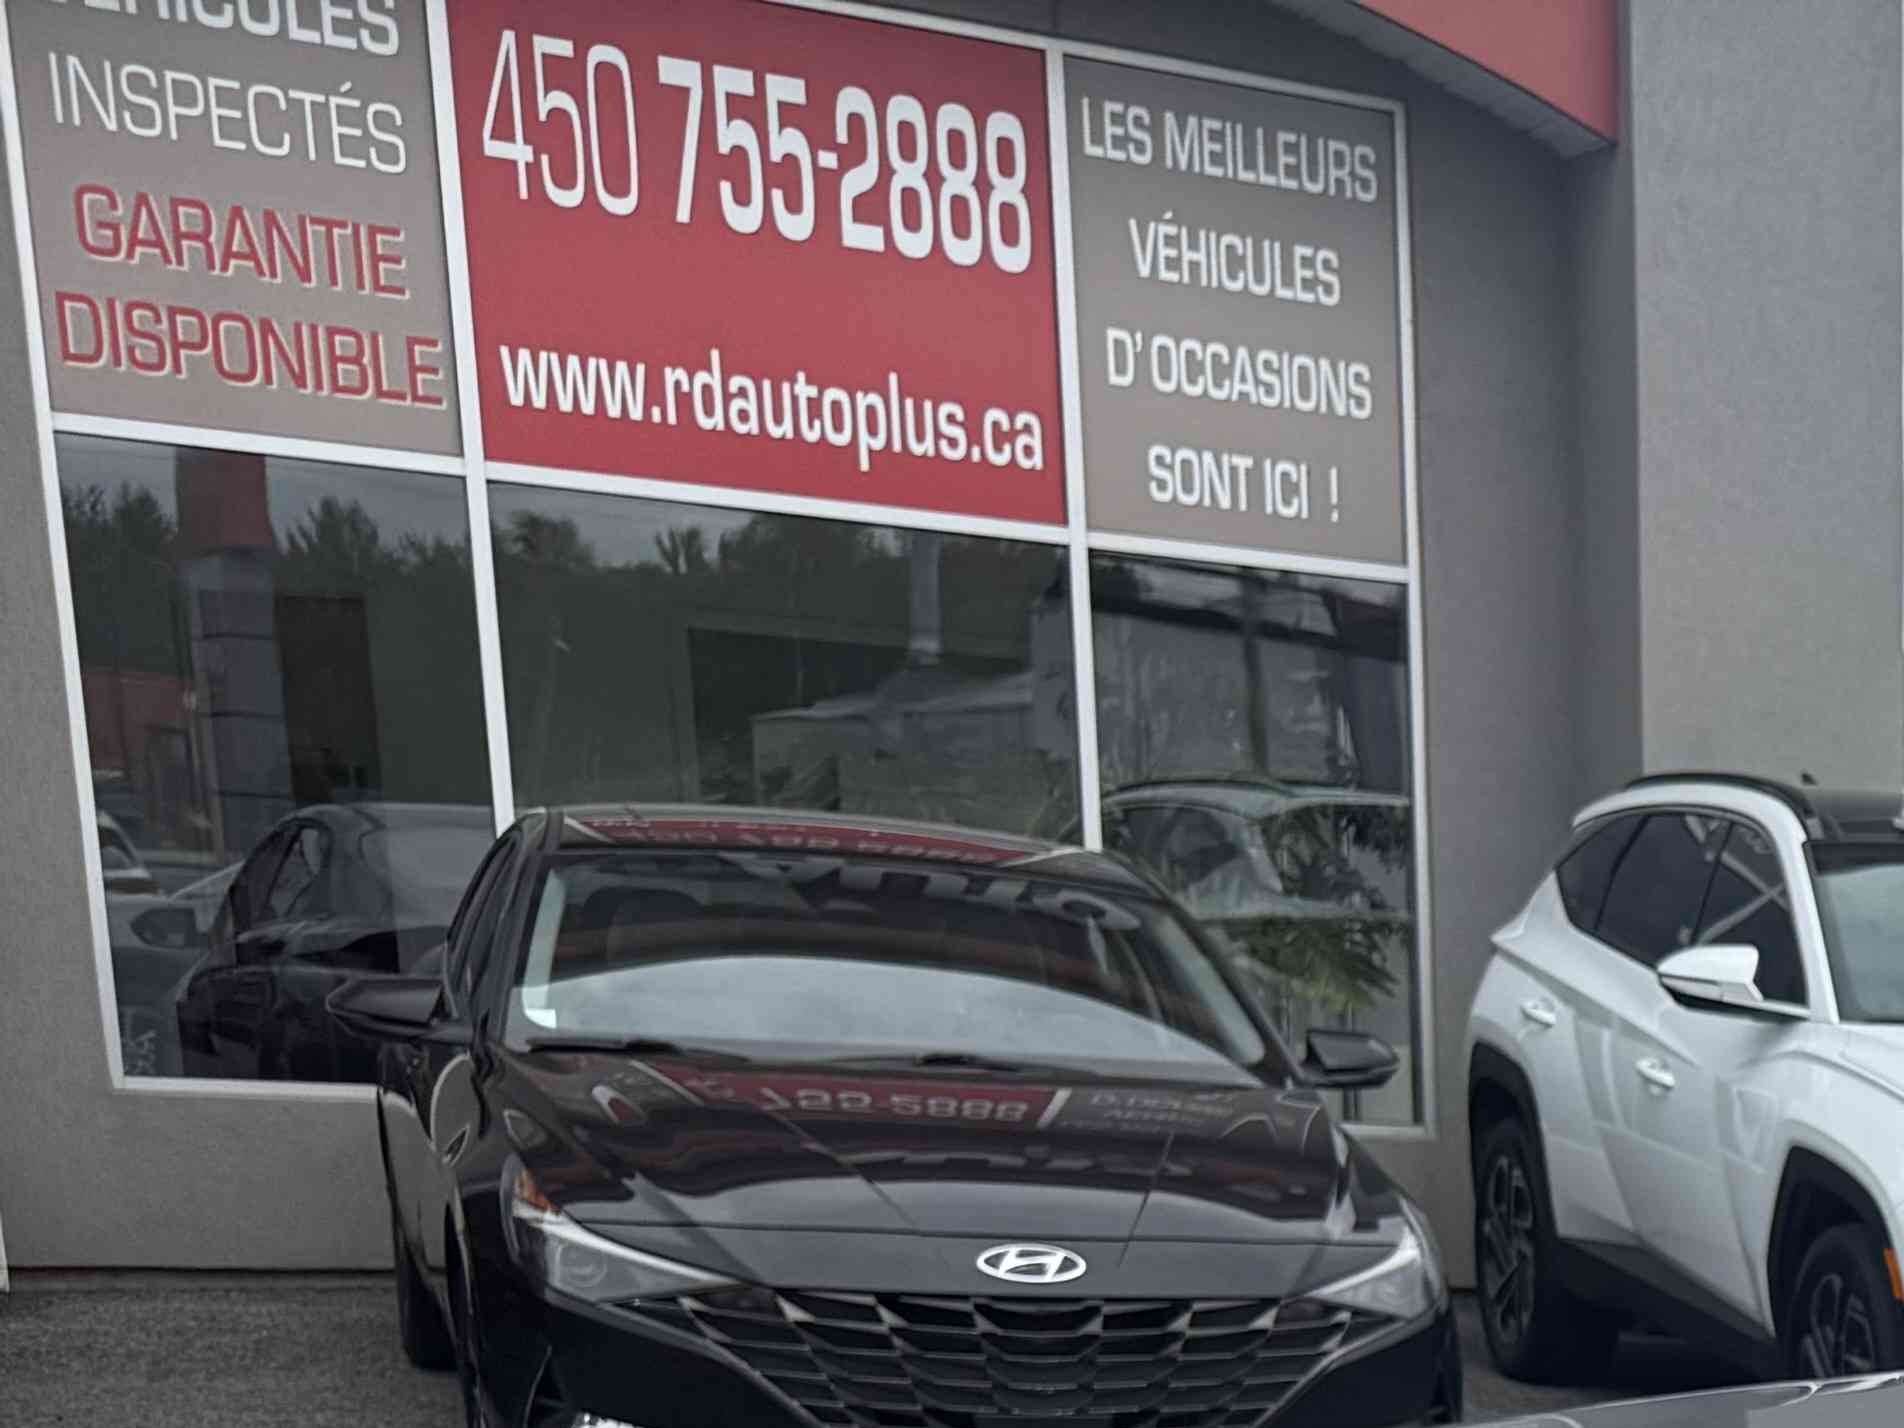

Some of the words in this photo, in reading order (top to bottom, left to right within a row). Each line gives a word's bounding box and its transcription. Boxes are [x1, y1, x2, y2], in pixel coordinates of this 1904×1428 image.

[48, 51, 407, 173] INSPECTÉS
[482, 29, 639, 217] 450
[657, 54, 1032, 274] 755-2888
[1081, 96, 1153, 166] LES
[1164, 111, 1378, 202] MEILLEURS
[73, 183, 410, 301] GARANTIE
[1128, 211, 1341, 306] VÉHICULES
[55, 290, 447, 410] DISPONIBLE
[499, 345, 1044, 472] www.rdautoplus.ca
[1148, 444, 1254, 512] SONT
[1263, 457, 1309, 519] ICI
